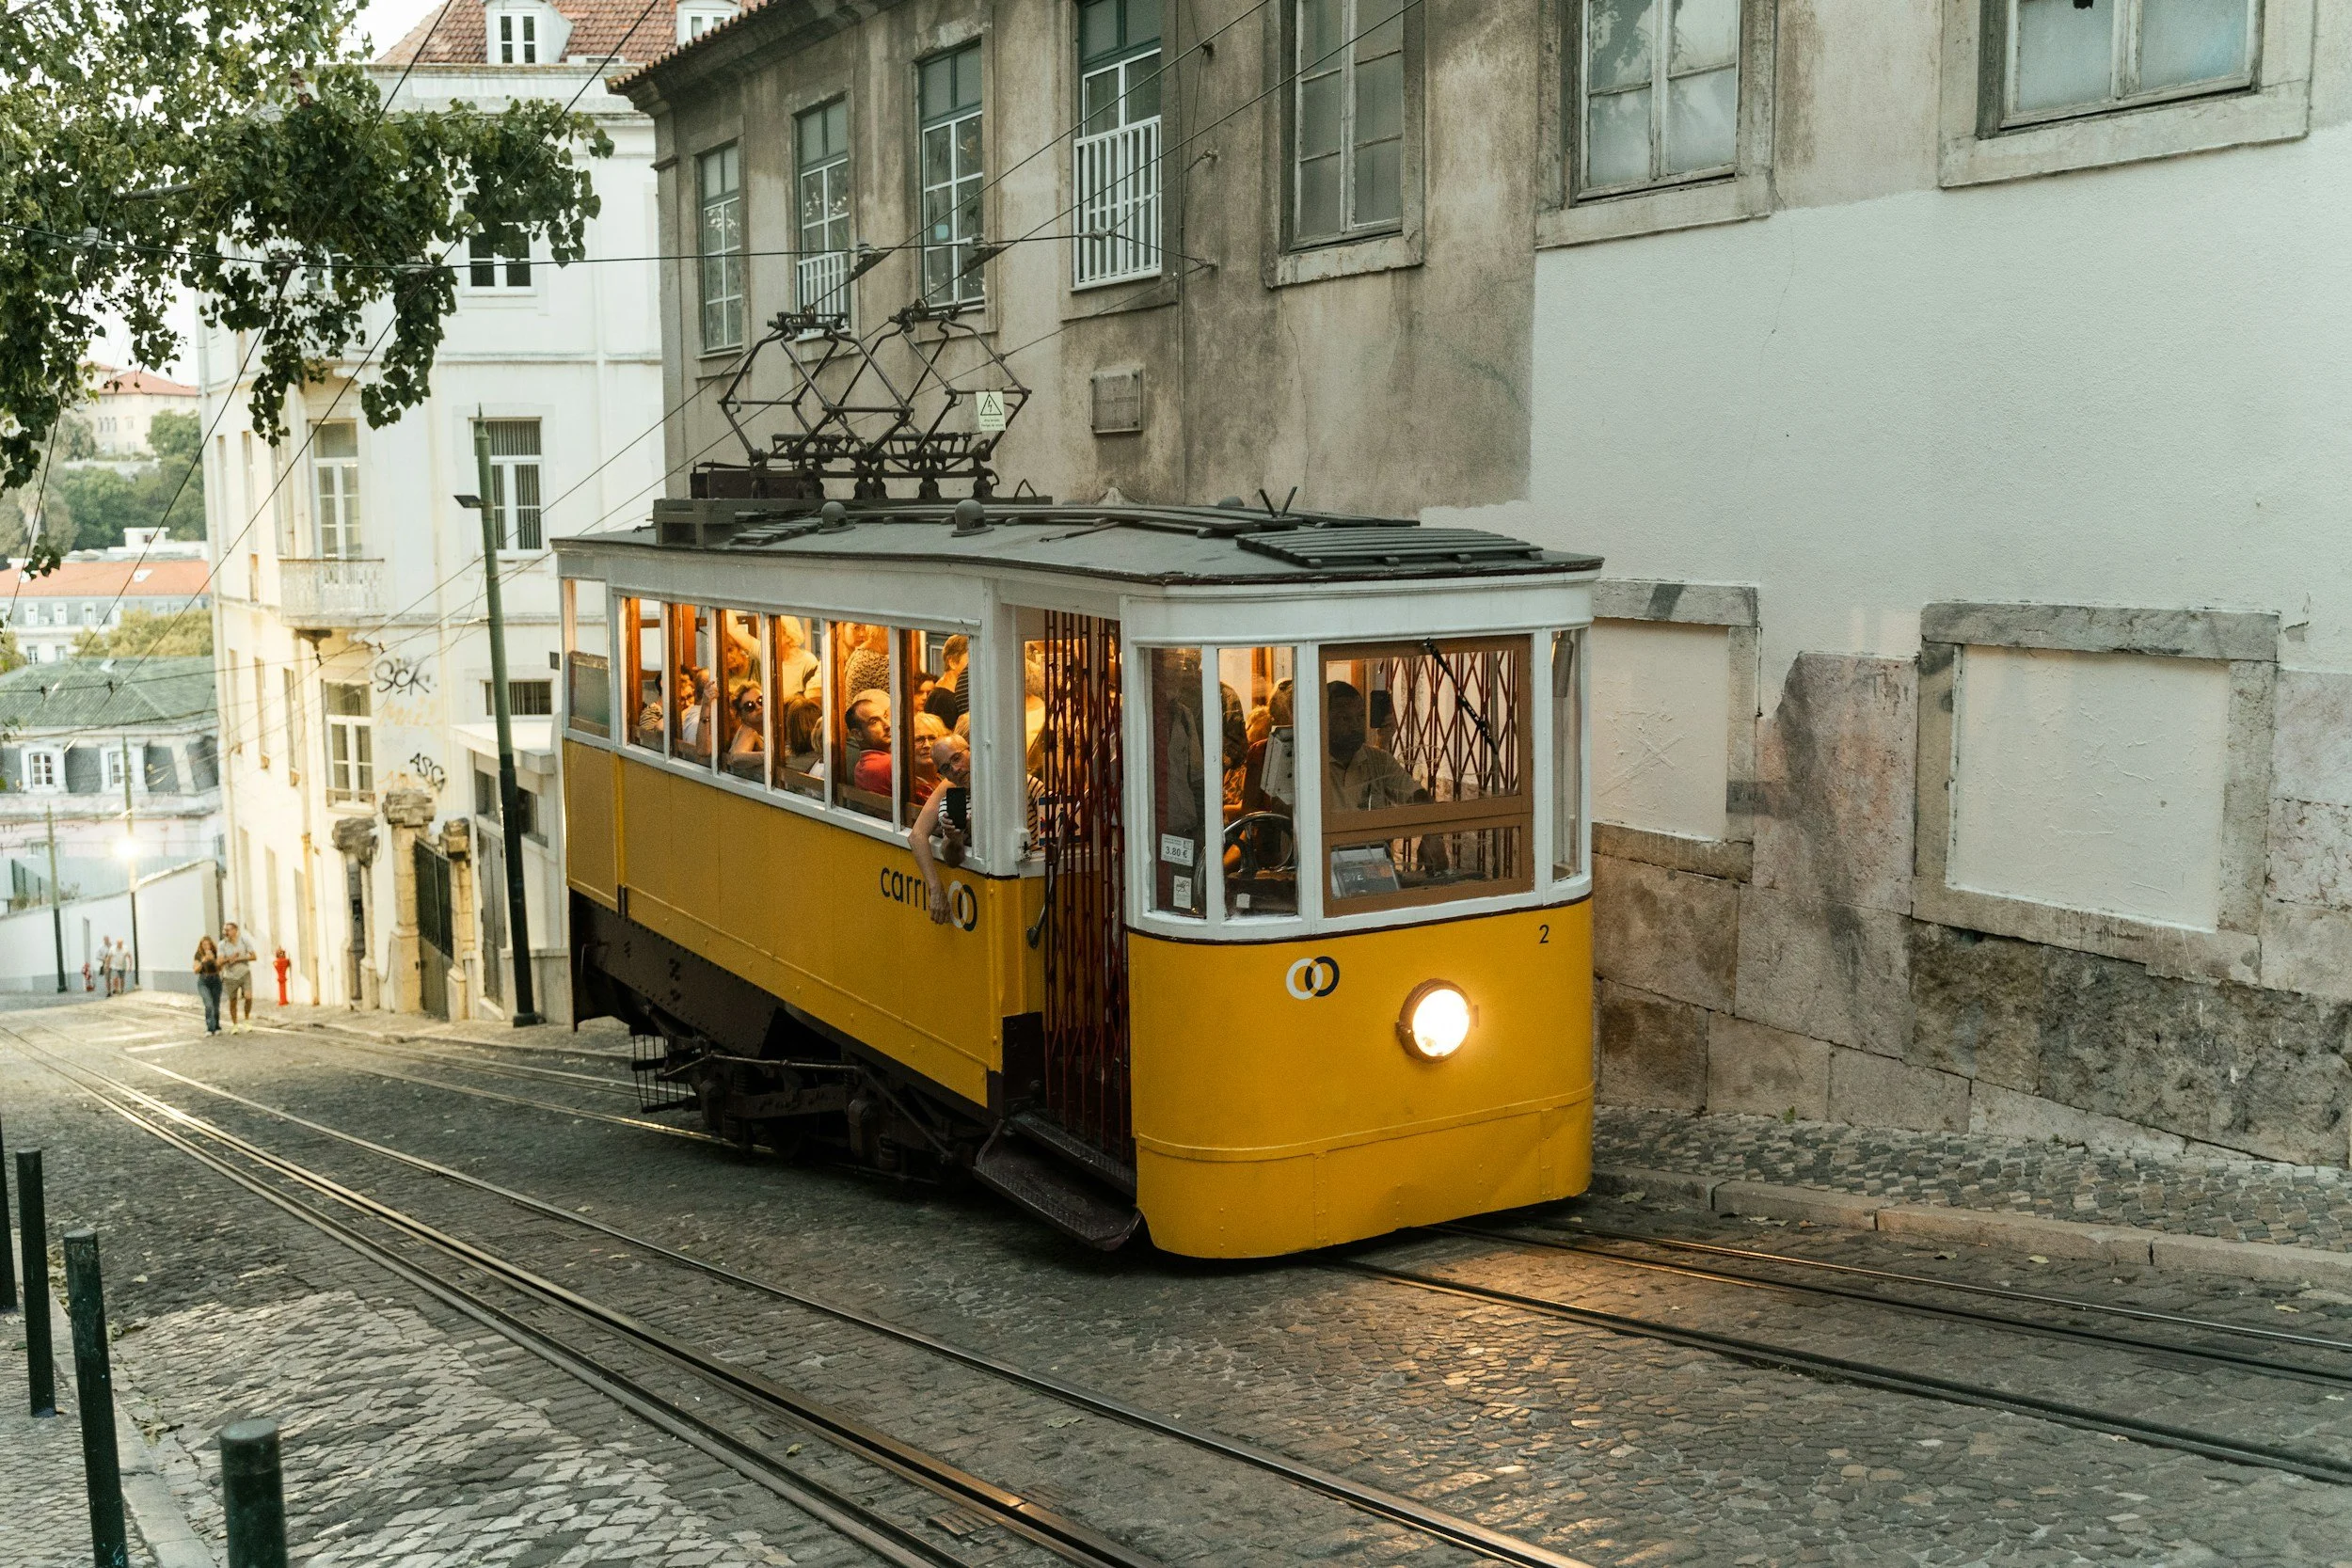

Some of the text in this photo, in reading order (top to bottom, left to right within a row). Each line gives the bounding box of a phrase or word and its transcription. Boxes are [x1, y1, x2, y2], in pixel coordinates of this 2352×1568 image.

[1166, 846, 1182, 857] 3.80
[881, 867, 933, 911] carri
[1539, 925, 1549, 944] 2
